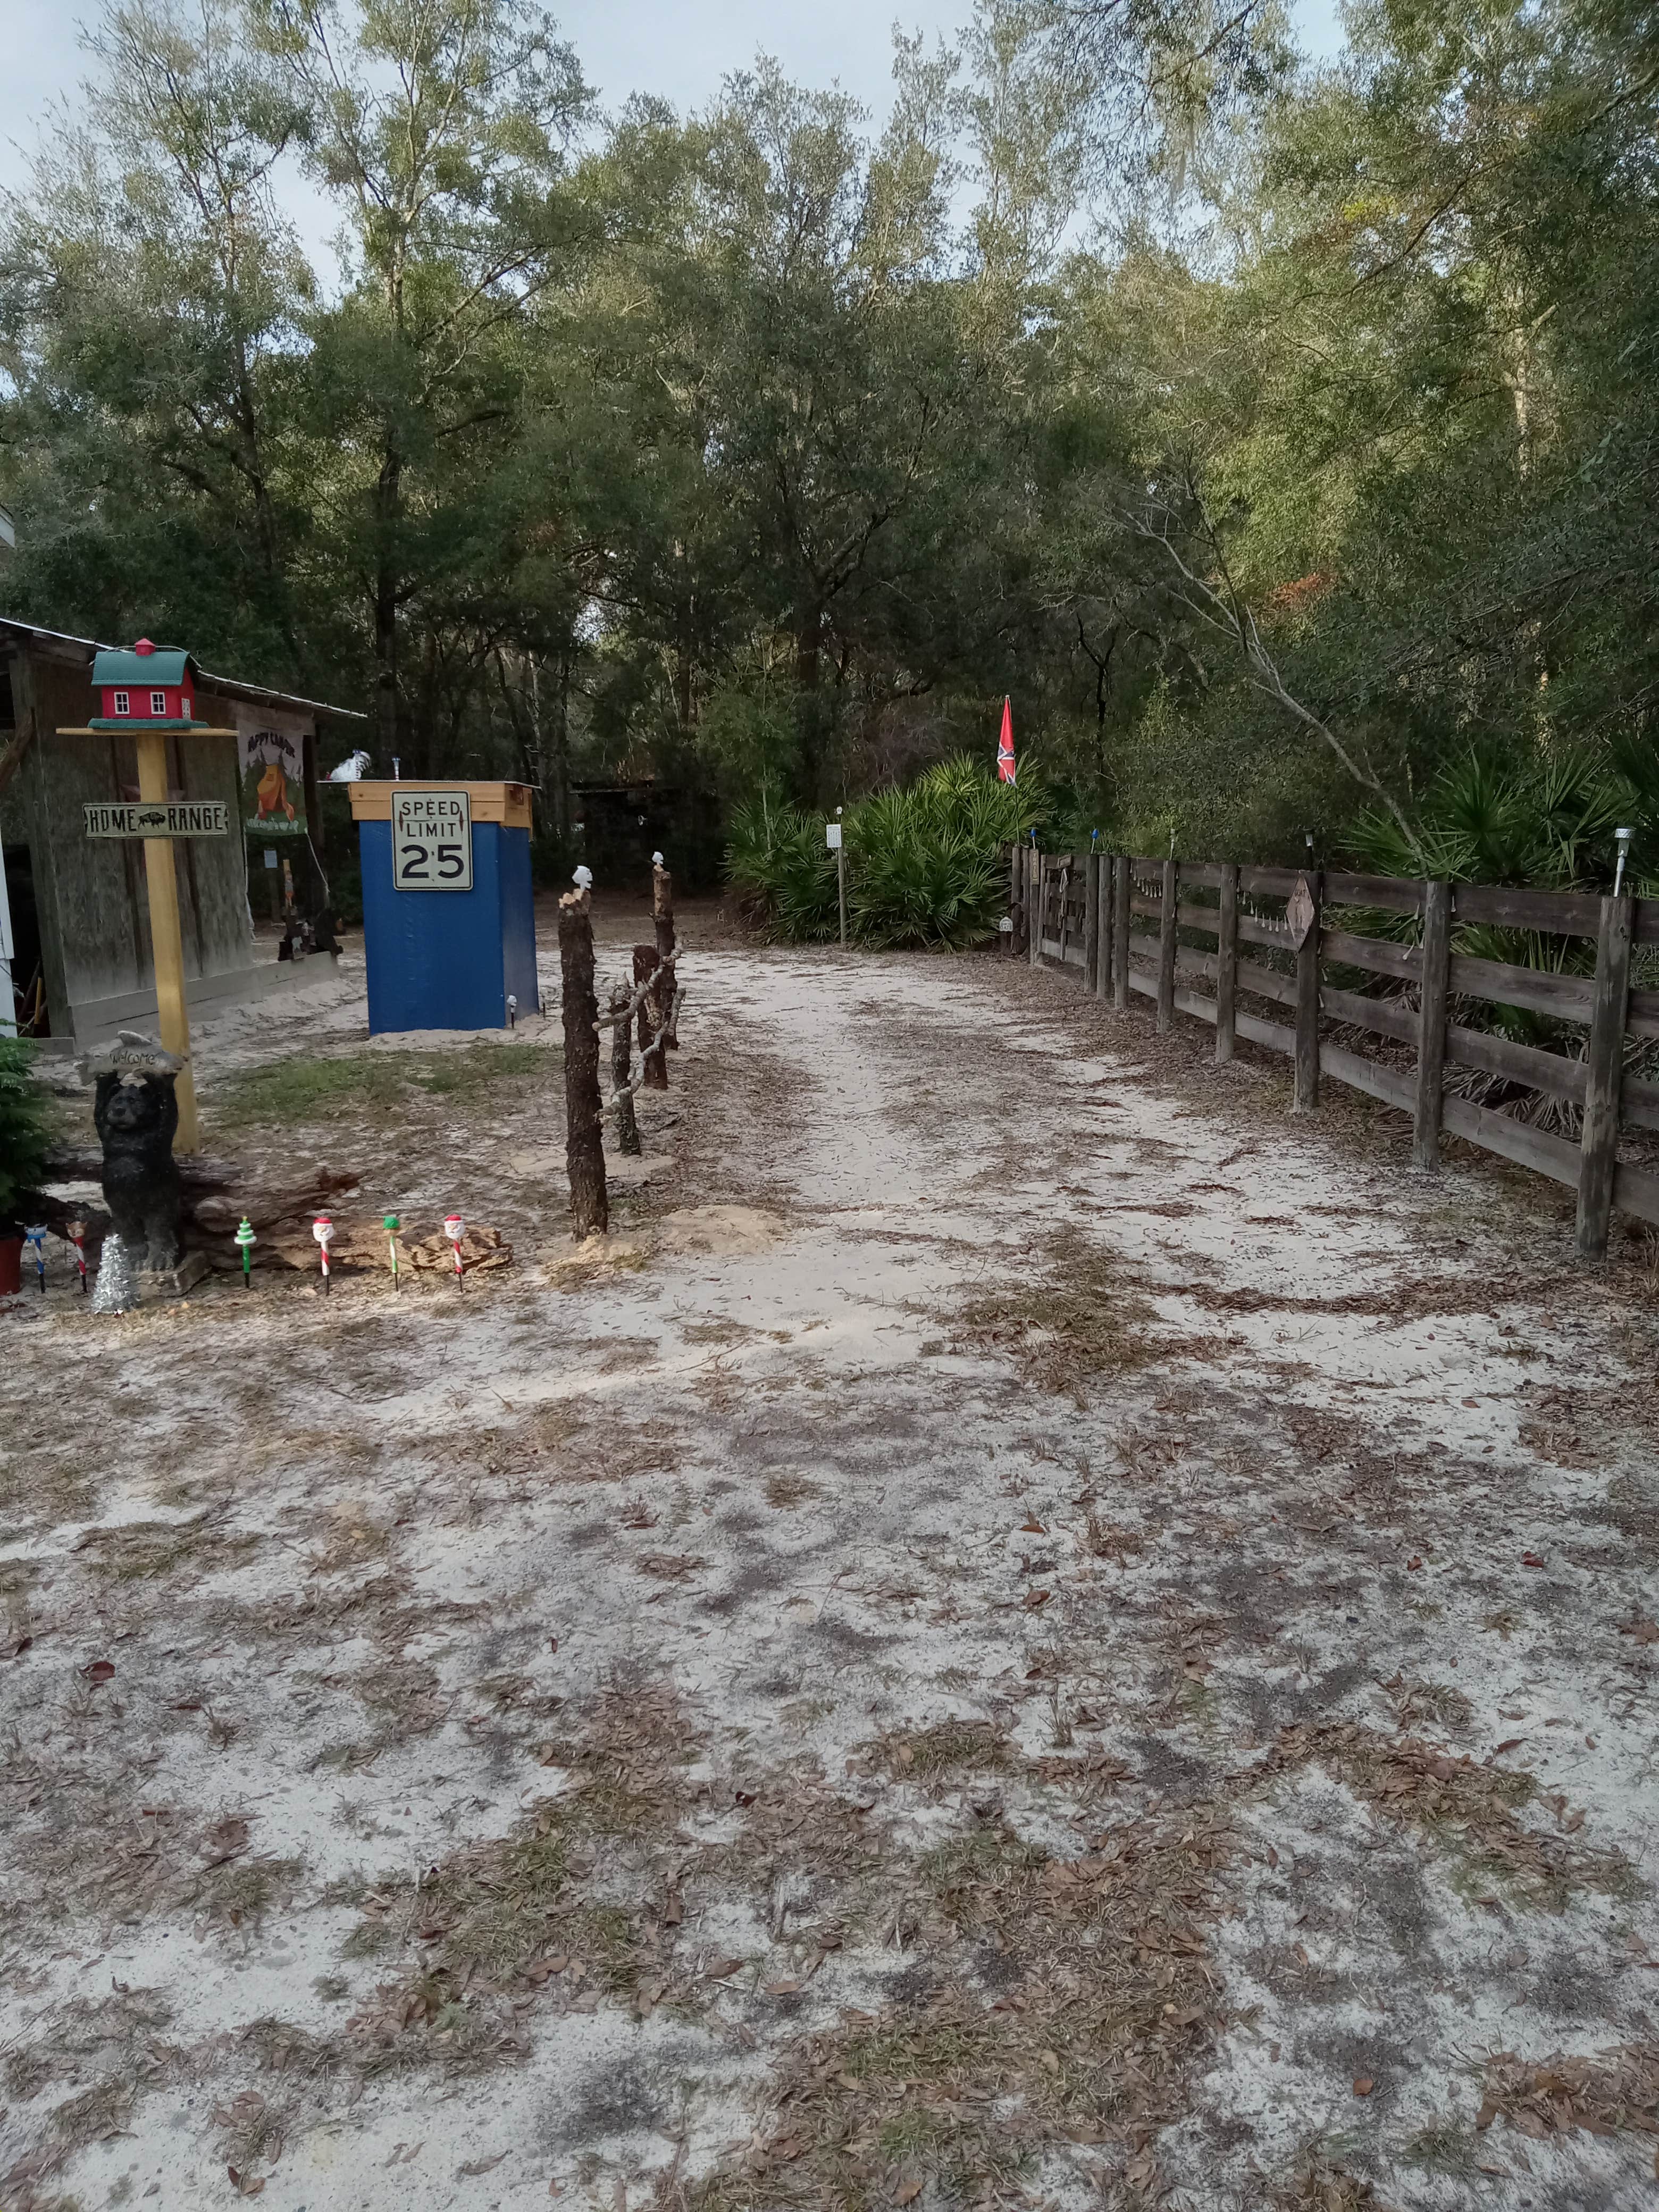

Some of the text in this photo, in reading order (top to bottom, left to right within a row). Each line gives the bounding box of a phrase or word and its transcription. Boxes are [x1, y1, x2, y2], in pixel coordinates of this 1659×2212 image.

[402, 801, 460, 816] SPEED
[89, 808, 137, 832] HOME
[167, 807, 223, 831] RANGE
[407, 823, 456, 837] LIMIT
[400, 844, 464, 879] 25
